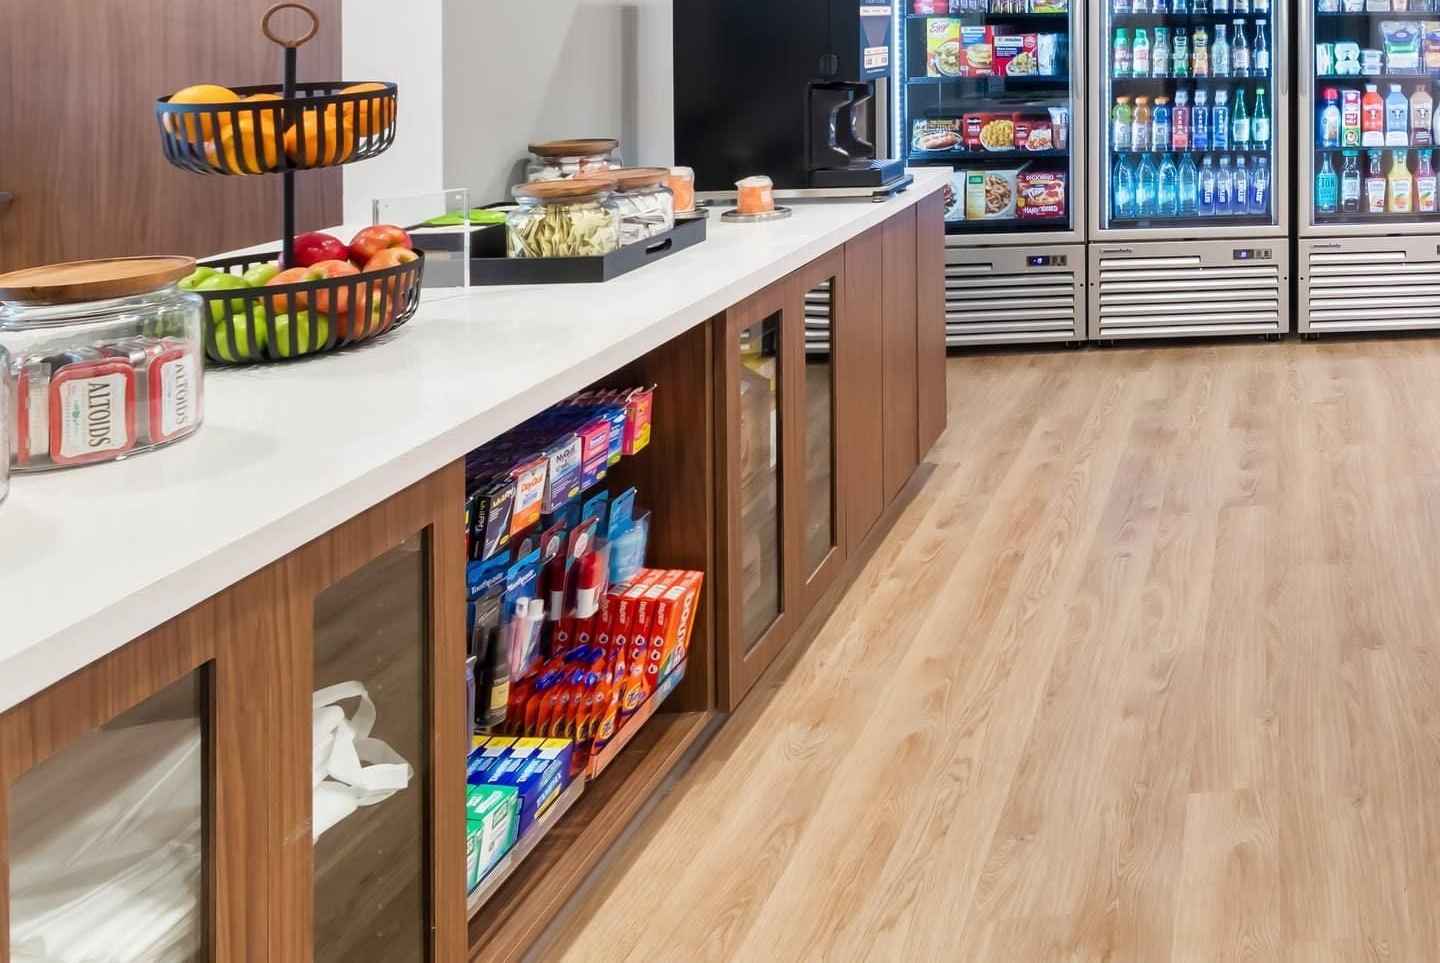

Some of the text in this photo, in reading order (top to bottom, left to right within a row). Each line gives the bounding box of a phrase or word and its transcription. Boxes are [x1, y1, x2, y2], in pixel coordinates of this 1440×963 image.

[175, 364, 189, 425] ALTOIDS
[88, 382, 111, 448] ALTOIDS
[556, 444, 576, 464] NyQuil
[521, 474, 544, 493] DayQuil
